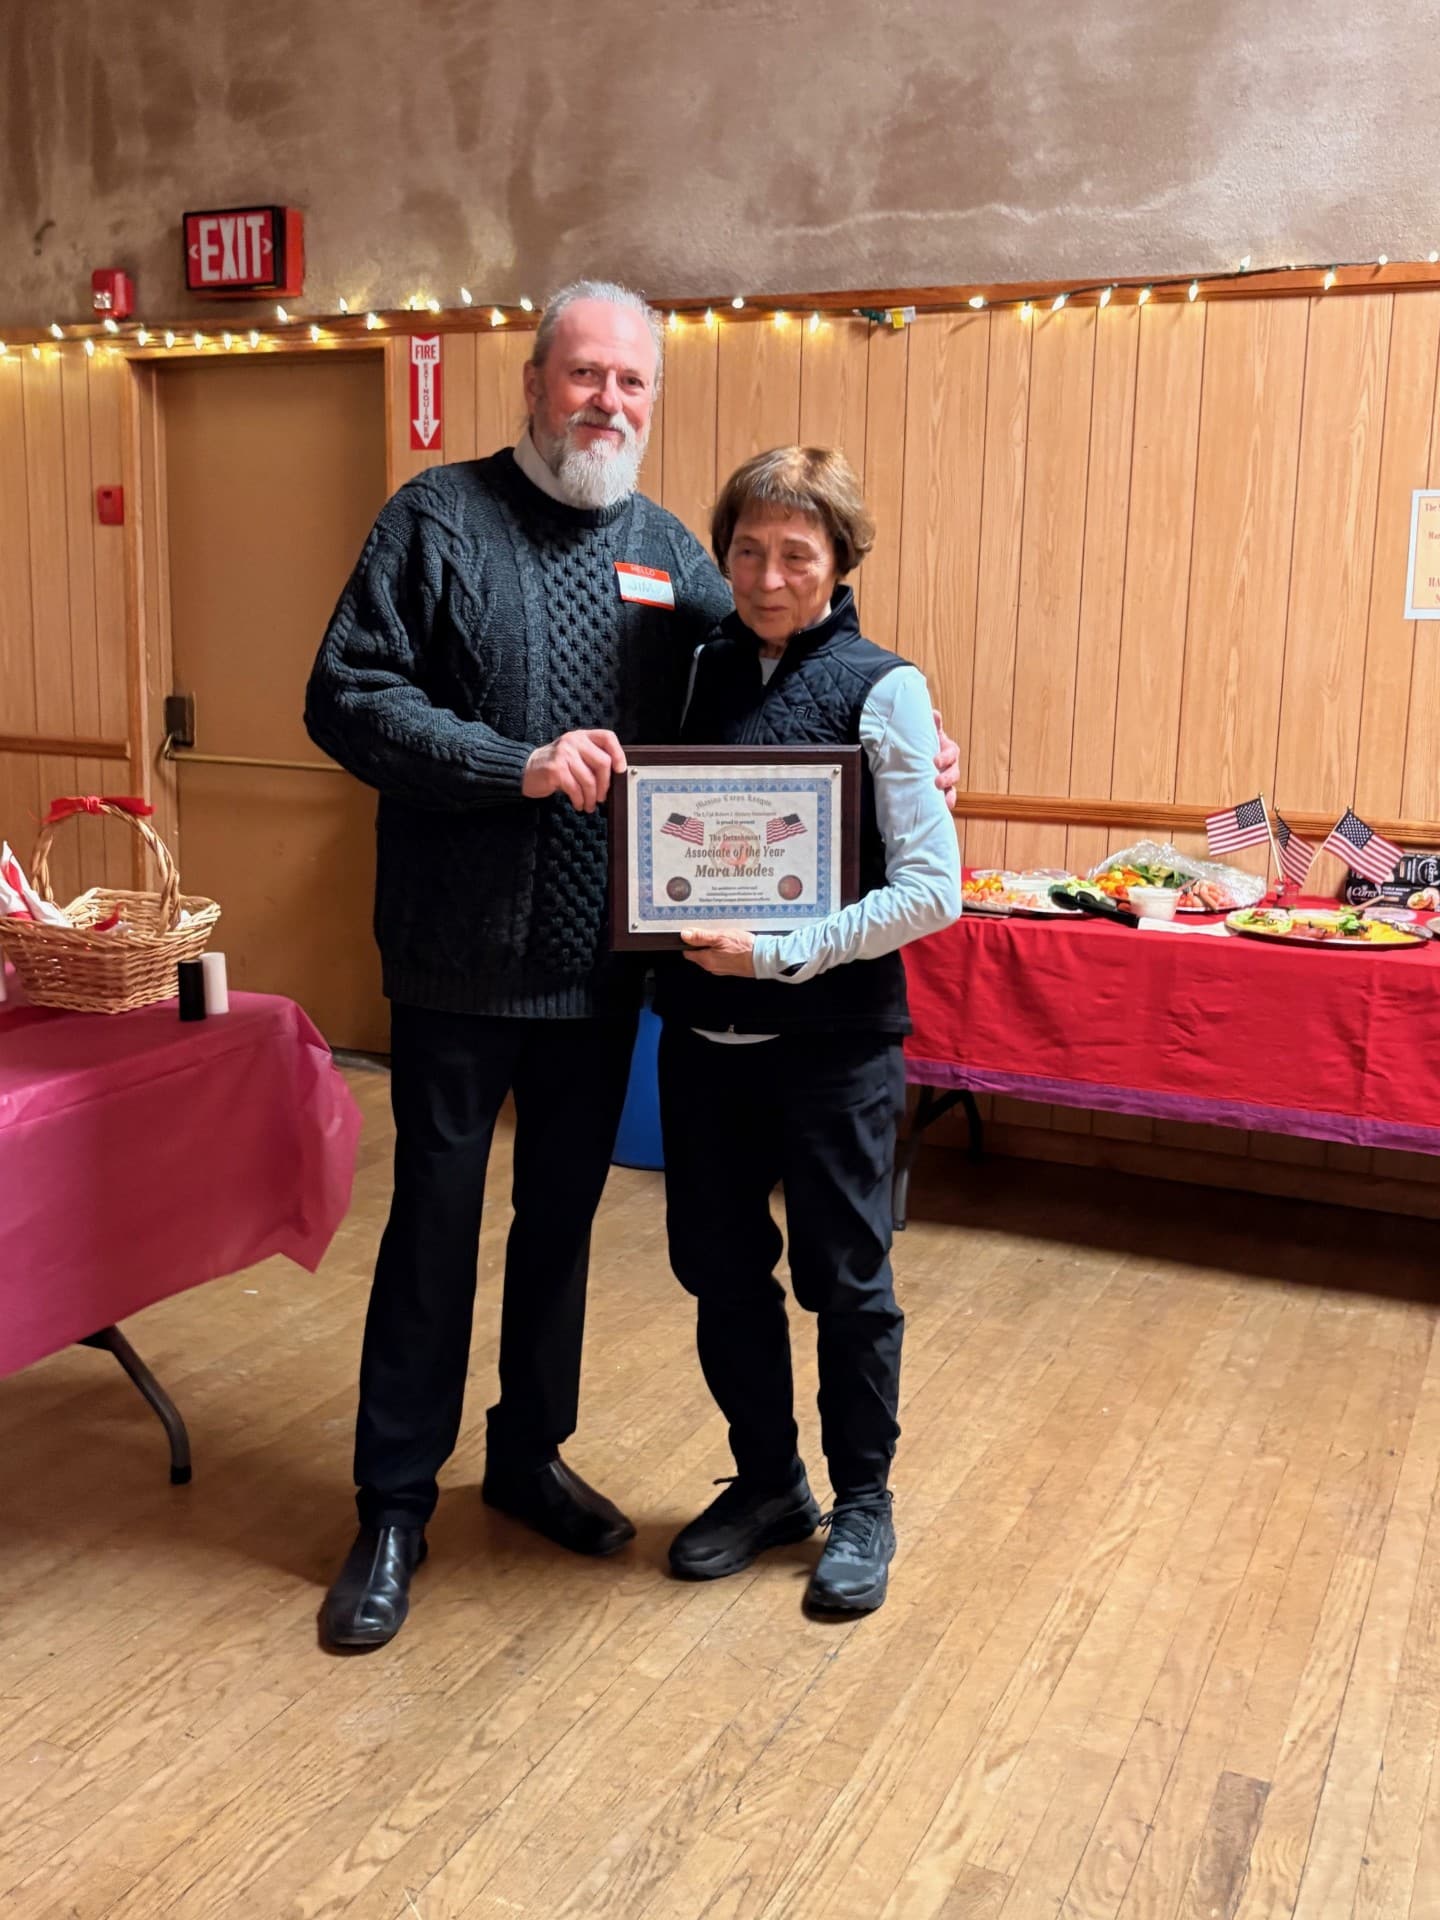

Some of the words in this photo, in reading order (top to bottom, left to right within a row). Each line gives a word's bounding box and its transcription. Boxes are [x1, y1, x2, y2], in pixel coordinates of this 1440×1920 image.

[199, 215, 264, 281] EXIT
[415, 344, 436, 359] FIRE
[709, 834, 721, 842] The
[723, 833, 761, 841] Detachment
[685, 846, 730, 858] Associate
[733, 846, 743, 860] of
[745, 845, 760, 857] the
[763, 846, 785, 857] Year
[695, 864, 730, 878] Mara
[733, 863, 774, 877] Modes
